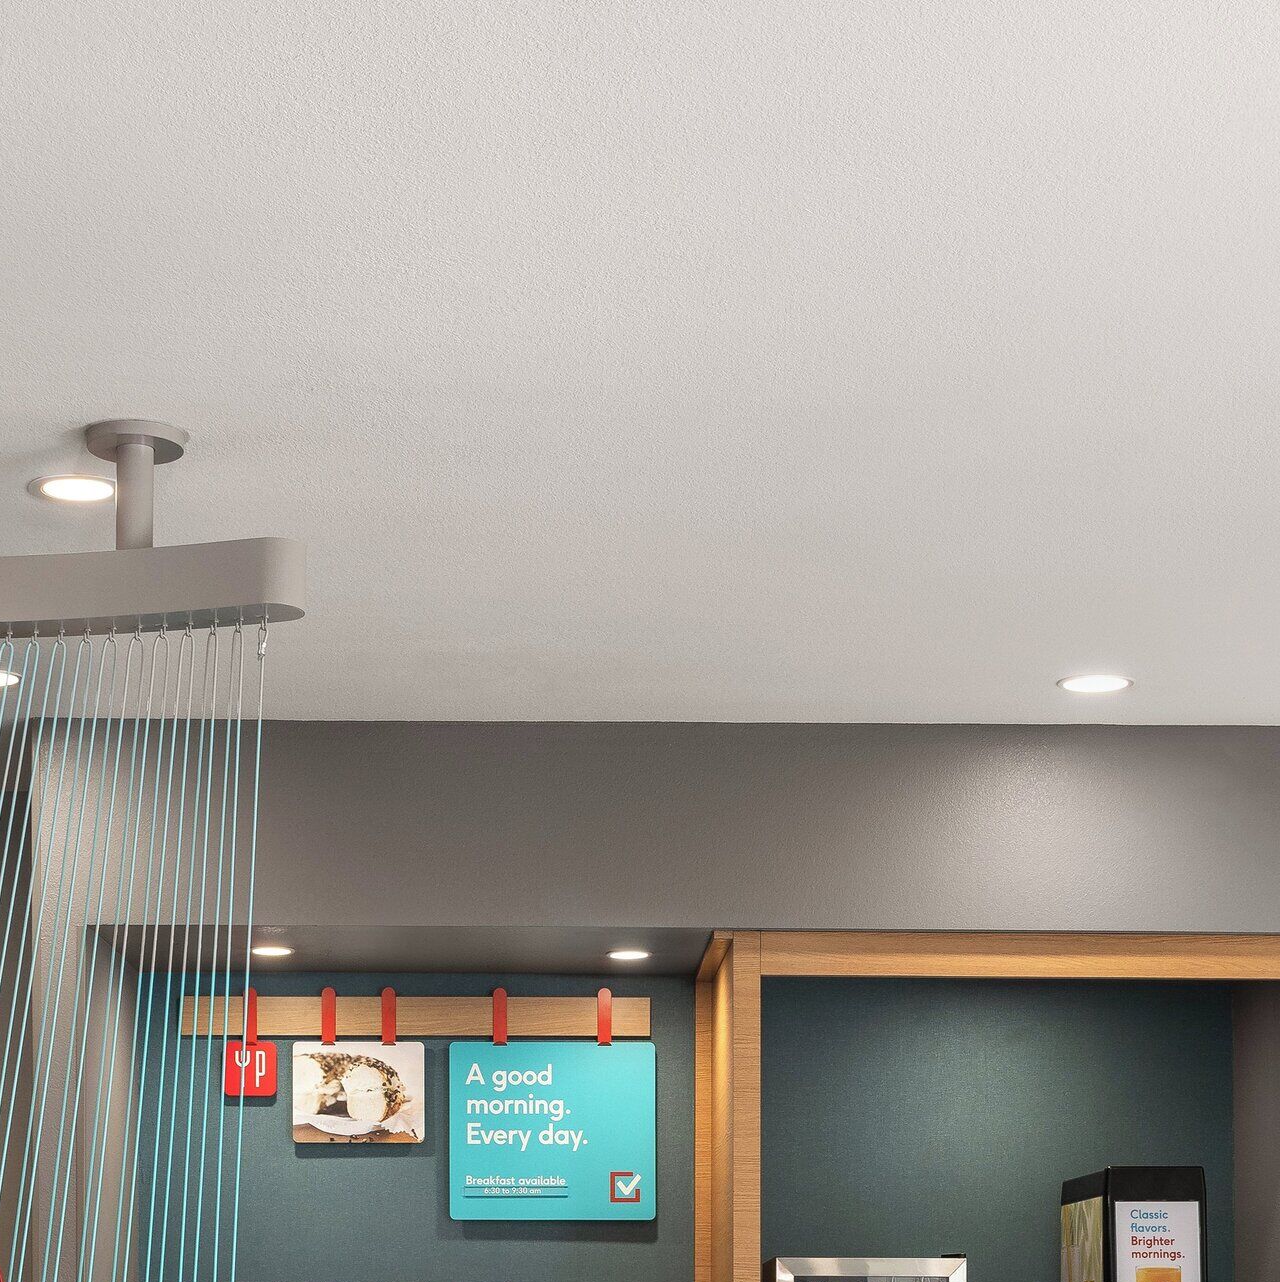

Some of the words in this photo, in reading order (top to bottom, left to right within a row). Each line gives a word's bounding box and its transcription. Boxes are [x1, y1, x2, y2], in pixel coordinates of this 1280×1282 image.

[465, 1063, 485, 1084] A
[492, 1064, 552, 1091] good
[466, 1093, 571, 1121] morning.
[466, 1123, 532, 1151] Every
[538, 1123, 588, 1151] day.
[465, 1175, 515, 1185] Breakfast
[518, 1175, 566, 1185] available
[1130, 1209, 1169, 1219] Classic
[1130, 1223, 1171, 1232] flavors.
[1131, 1236, 1175, 1248] Brighter
[1131, 1249, 1185, 1261] mornings.
